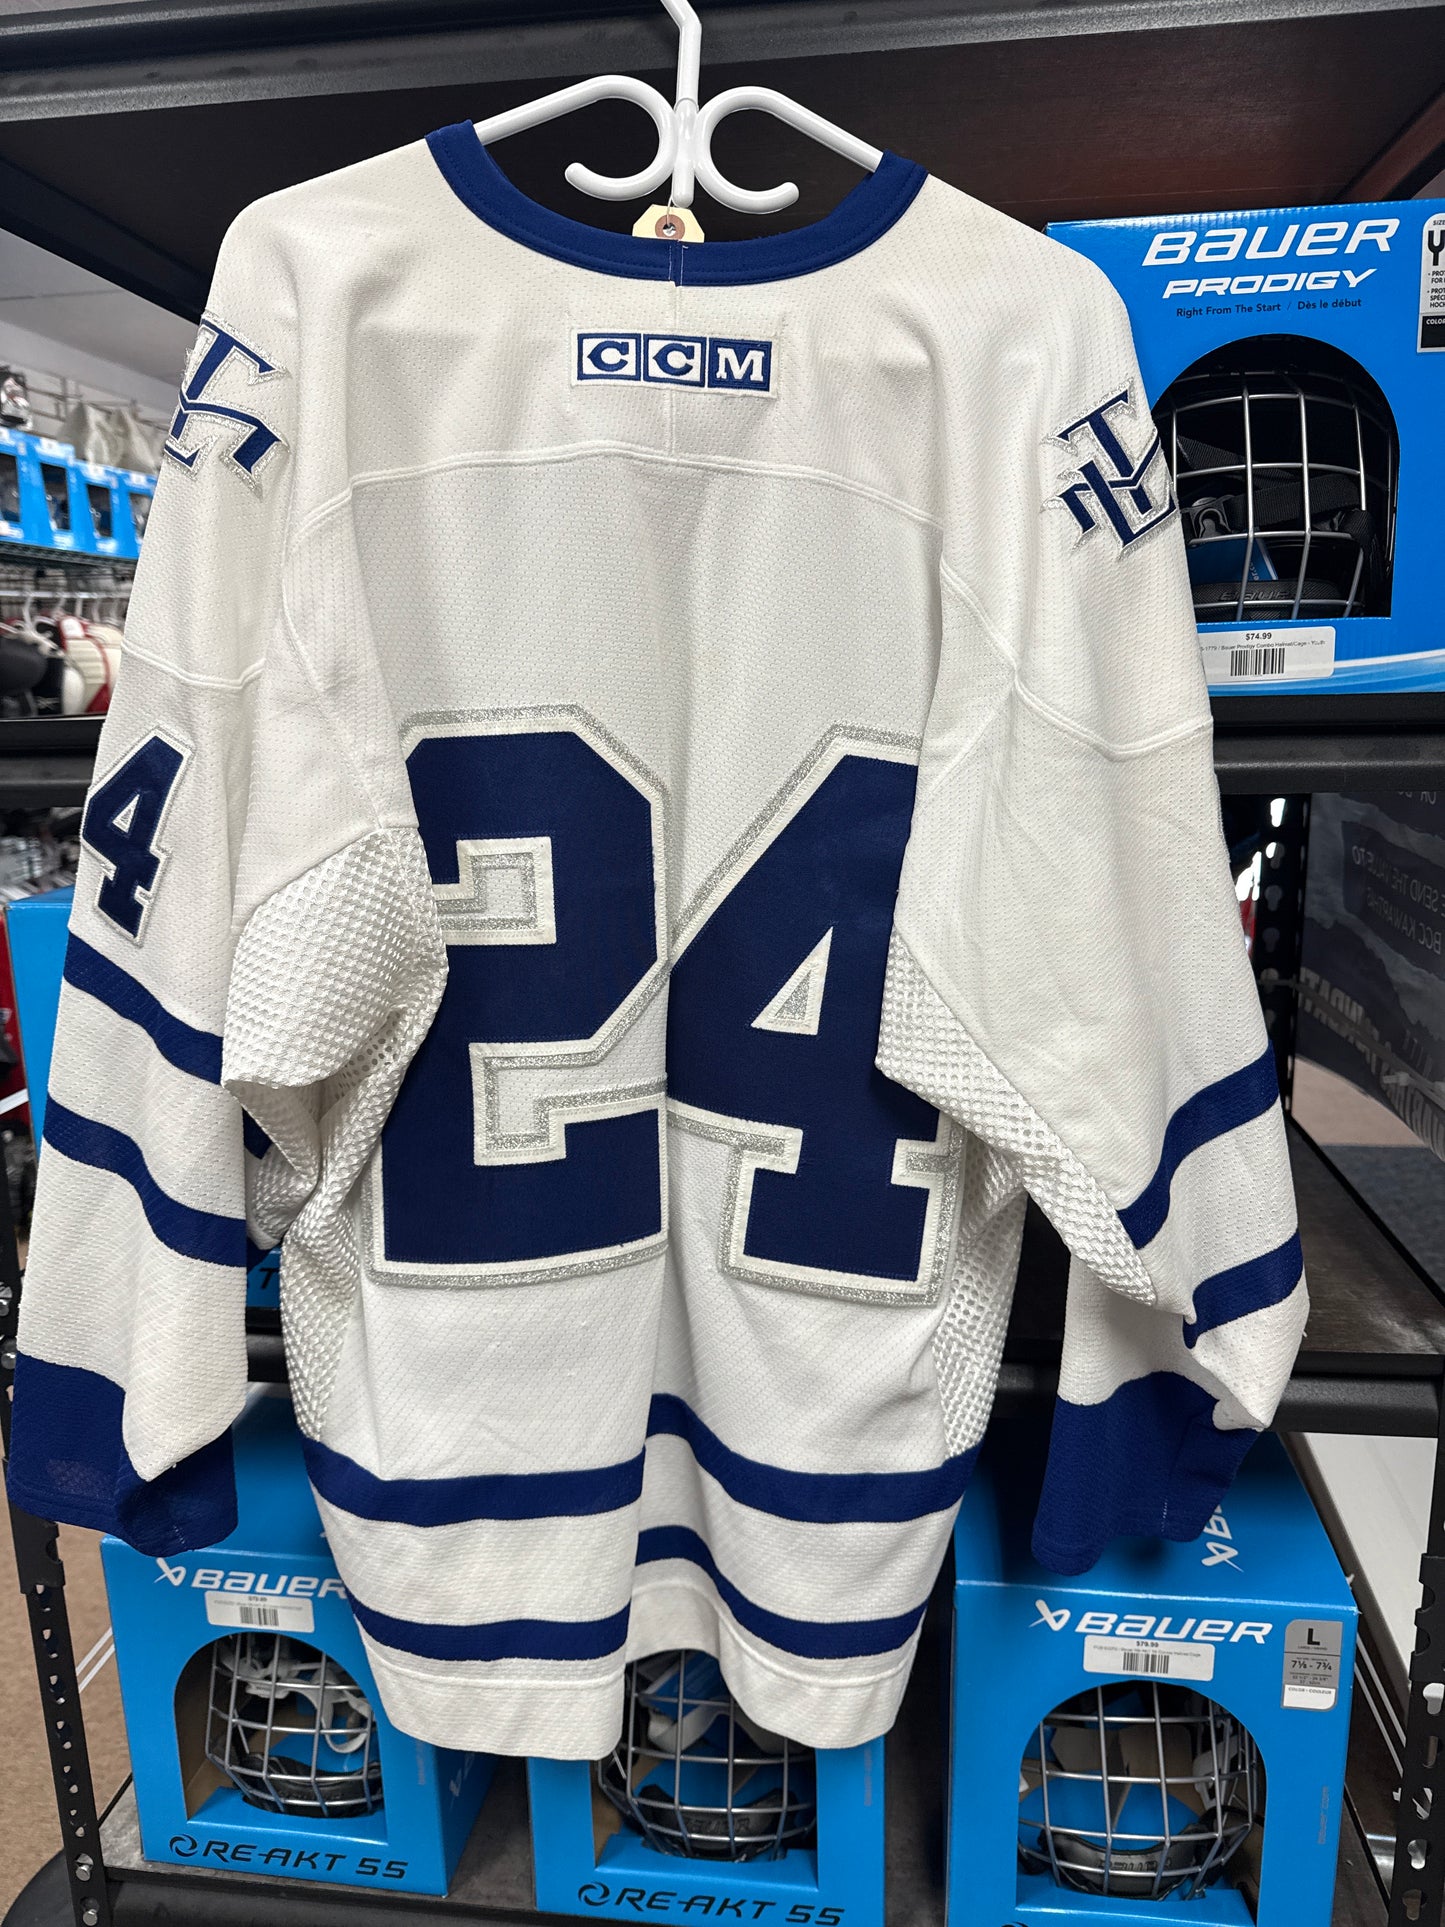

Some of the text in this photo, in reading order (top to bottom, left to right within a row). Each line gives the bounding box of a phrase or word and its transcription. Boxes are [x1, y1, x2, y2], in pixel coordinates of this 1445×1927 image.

[1162, 268, 1377, 299] PRODIGY
[1176, 307, 1203, 318] Right
[1206, 306, 1231, 316] From
[1235, 304, 1253, 313] The
[1256, 303, 1281, 312] Start
[1297, 300, 1316, 310] Dès
[1319, 299, 1328, 309] le
[1331, 298, 1362, 308] début
[585, 338, 768, 384] CCM
[1245, 632, 1272, 641] $74.99
[1256, 641, 1274, 649] Combo
[81, 729, 192, 942] 4
[370, 708, 960, 1299] 24
[1307, 1628, 1320, 1645] L
[202, 1840, 347, 1871] RE-AKT
[615, 1888, 776, 1919] RE-AKT
